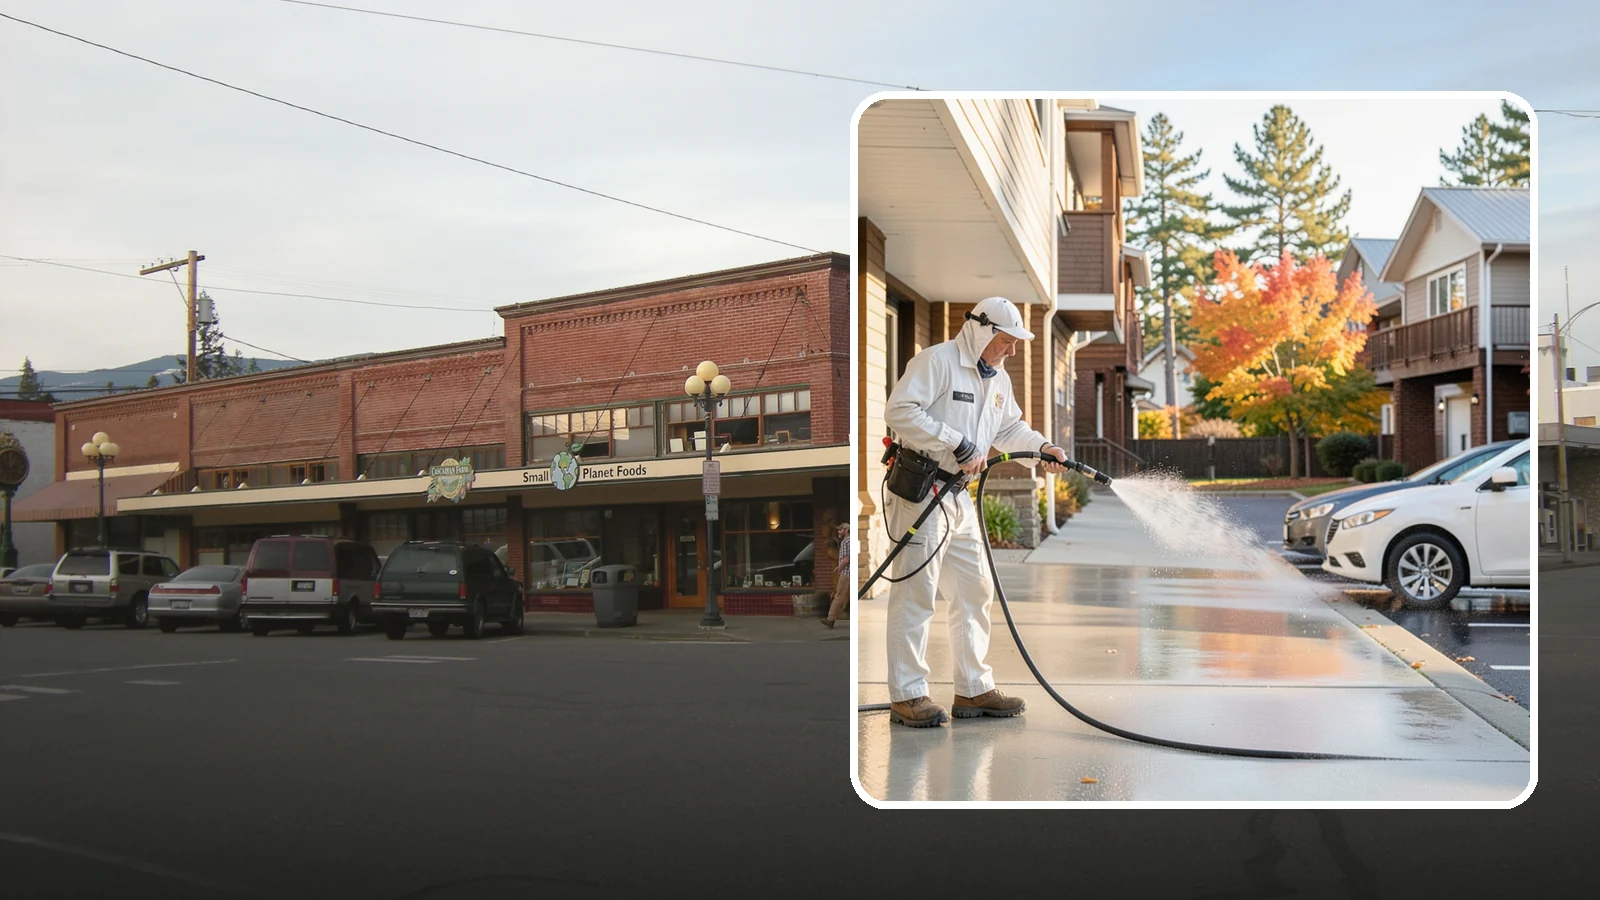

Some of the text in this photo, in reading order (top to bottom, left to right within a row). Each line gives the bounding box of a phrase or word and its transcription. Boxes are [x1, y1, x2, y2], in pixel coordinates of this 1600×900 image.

[523, 464, 647, 483] Small Planet Foods
